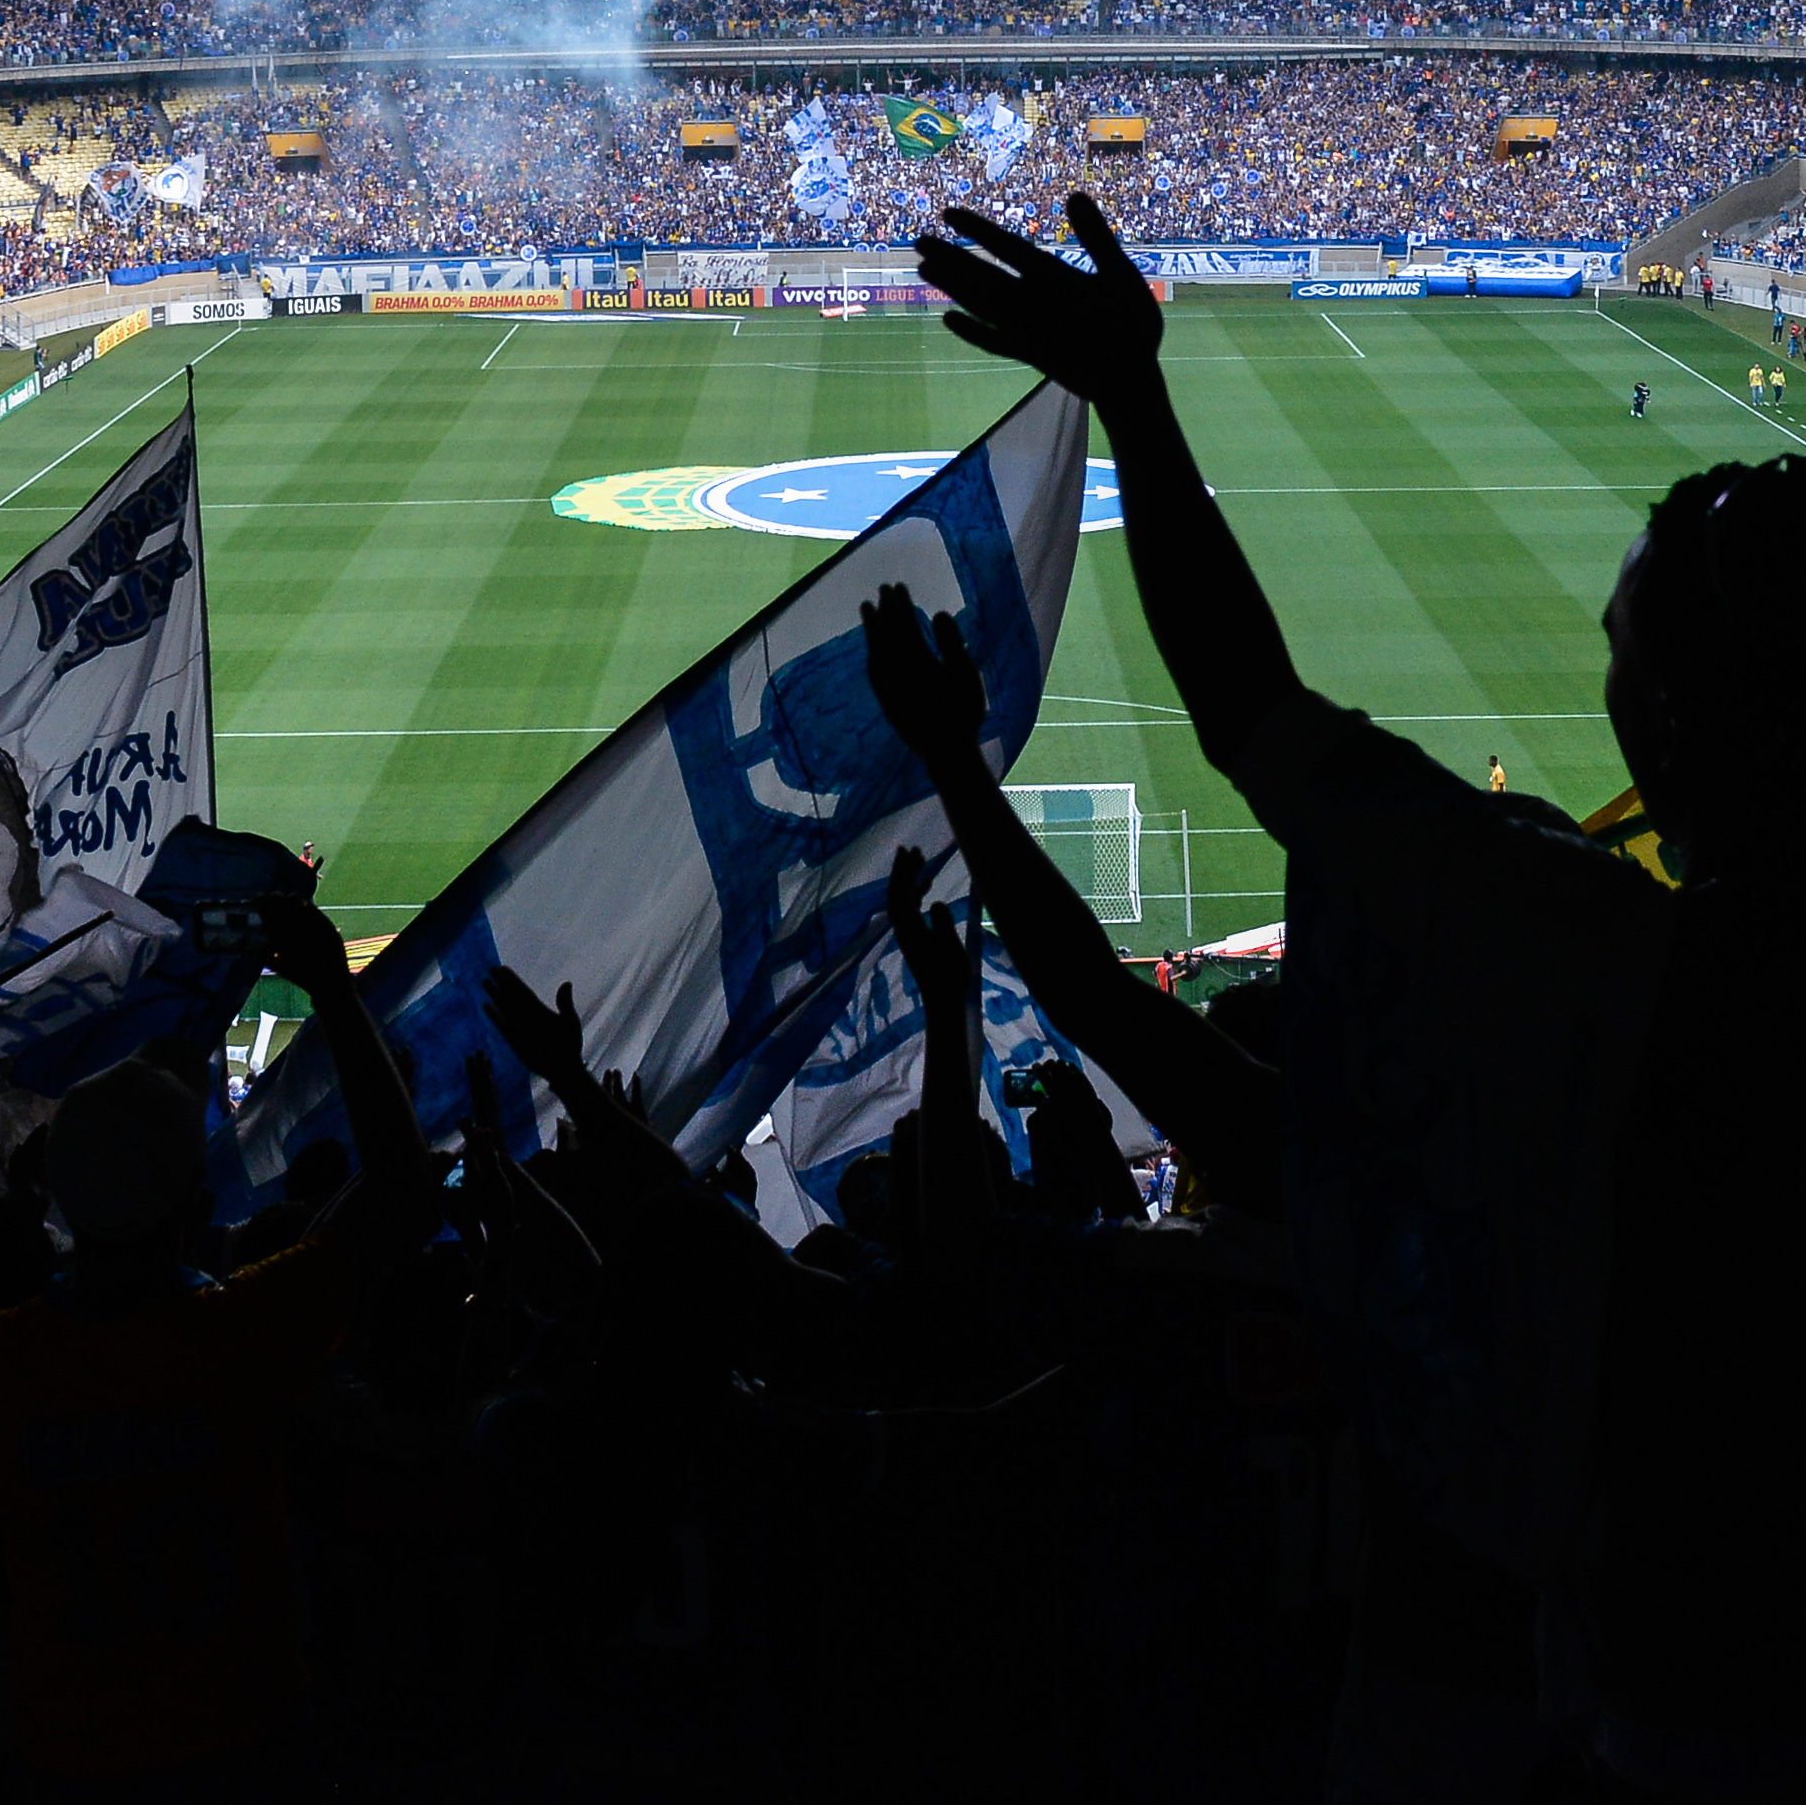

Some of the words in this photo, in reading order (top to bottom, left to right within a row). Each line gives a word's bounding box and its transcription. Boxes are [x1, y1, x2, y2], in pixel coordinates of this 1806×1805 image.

[782, 290, 825, 303] VIVO
[827, 289, 871, 302] TUDO
[876, 289, 915, 302] LIGUE
[1339, 282, 1421, 296] OLYMPIKUS
[288, 295, 342, 315] IGUAIS
[375, 295, 430, 310] BRAHMA
[432, 295, 465, 310] 0,0%
[469, 294, 524, 309] BRAHMA
[526, 294, 558, 307] 0,0%
[586, 291, 627, 308] Itaú
[648, 291, 689, 307] Itaú
[709, 290, 750, 307] Itaú
[192, 302, 245, 319] SOMOS
